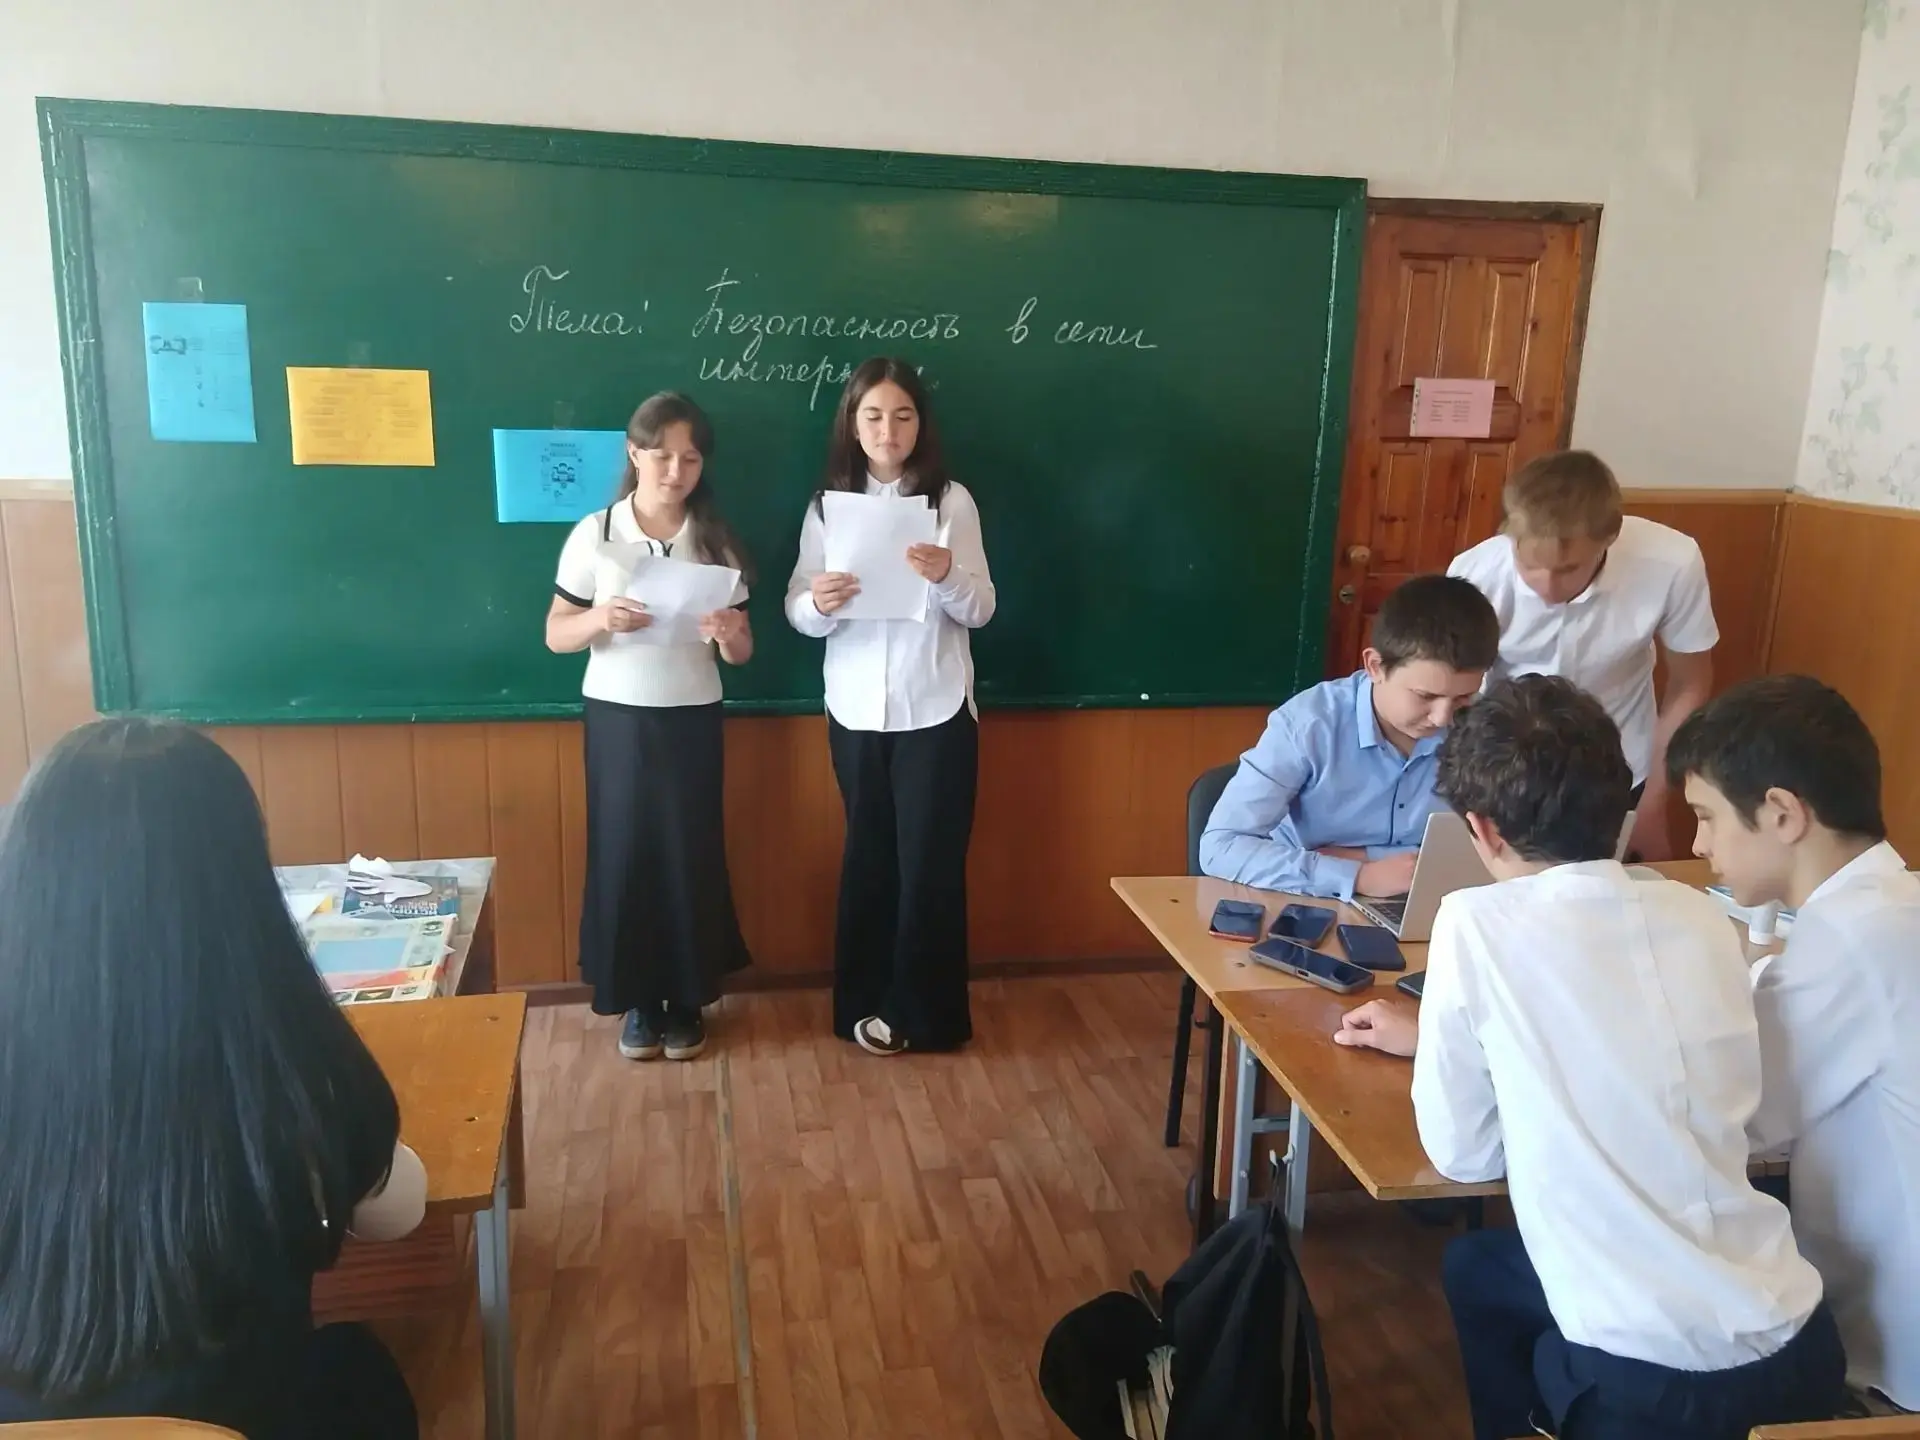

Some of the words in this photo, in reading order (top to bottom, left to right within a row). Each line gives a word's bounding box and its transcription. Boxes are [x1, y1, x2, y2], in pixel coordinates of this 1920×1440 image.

[692, 268, 960, 362] Безопасность
[1005, 297, 1038, 344] в
[1054, 320, 1158, 350] сети
